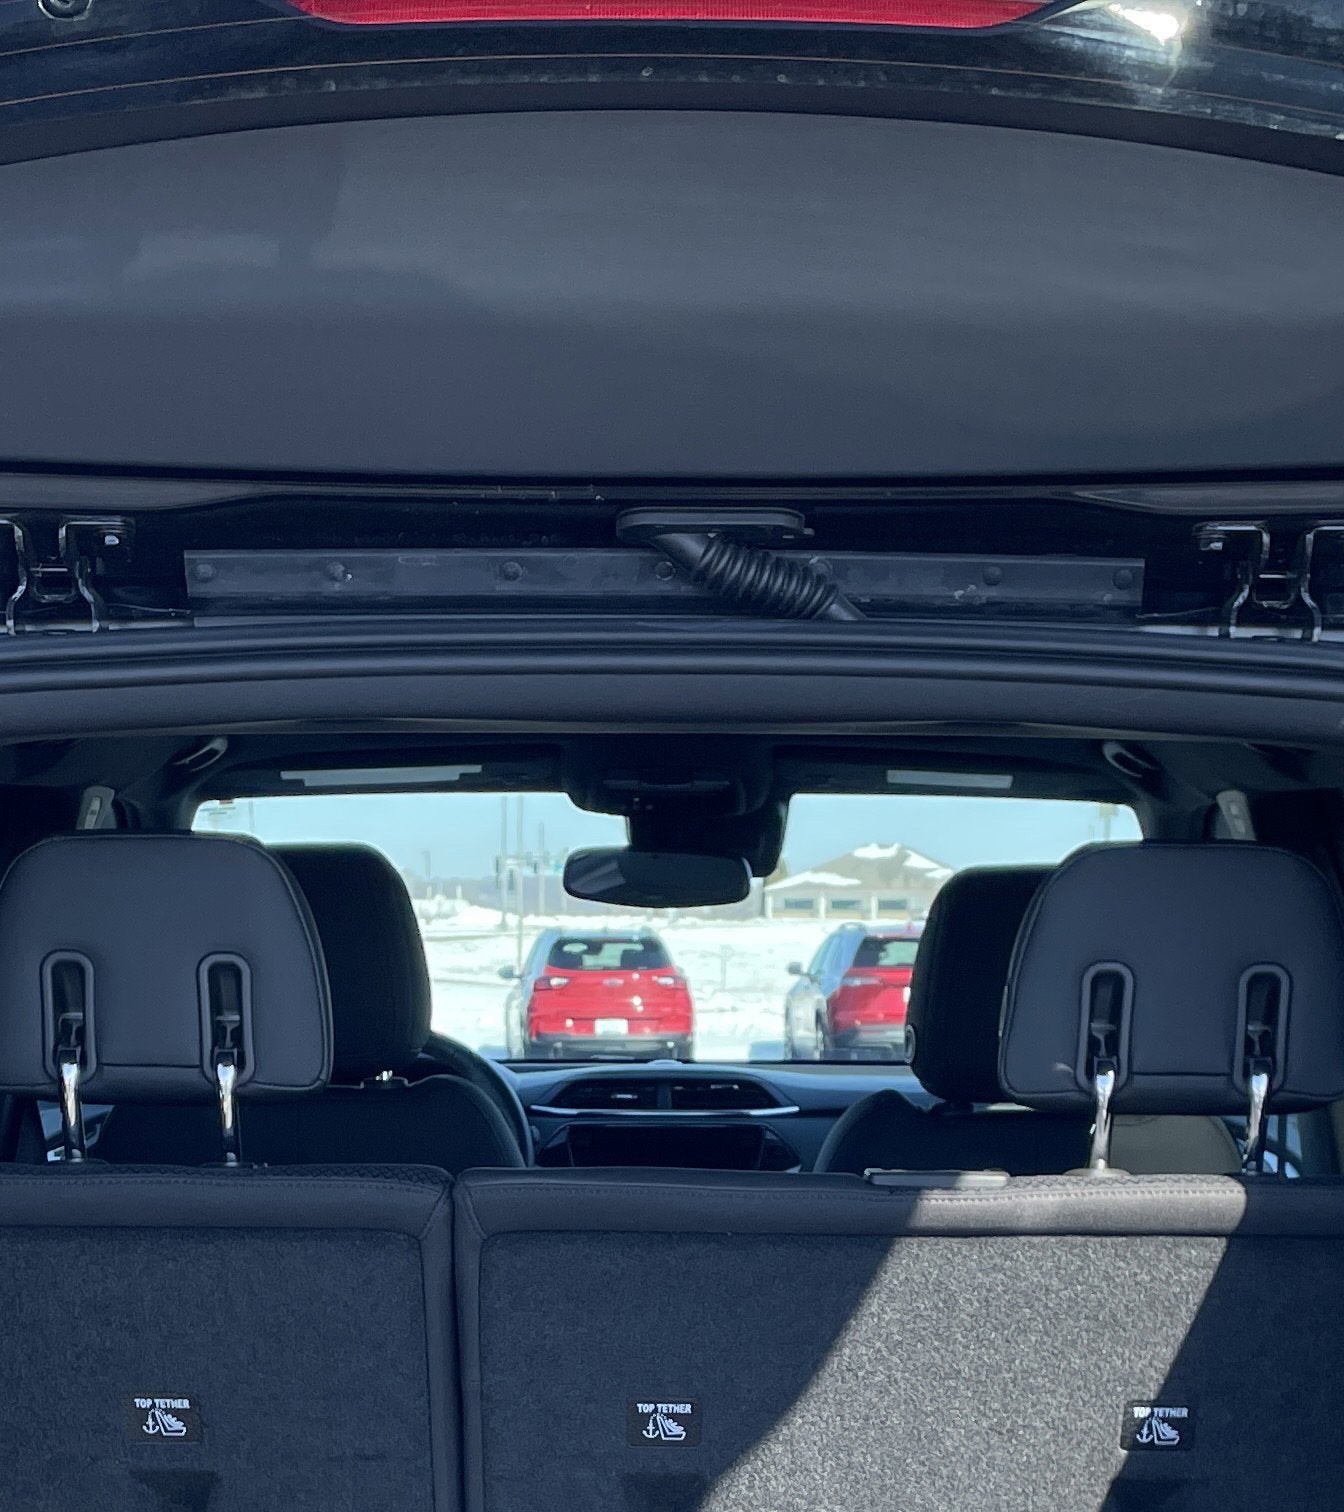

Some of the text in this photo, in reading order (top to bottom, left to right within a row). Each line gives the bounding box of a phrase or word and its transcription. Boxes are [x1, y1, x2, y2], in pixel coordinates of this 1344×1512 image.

[134, 1398, 190, 1409] TOP TETHER
[636, 1403, 692, 1414] TOP TETHER
[1133, 1406, 1152, 1418] TOP
